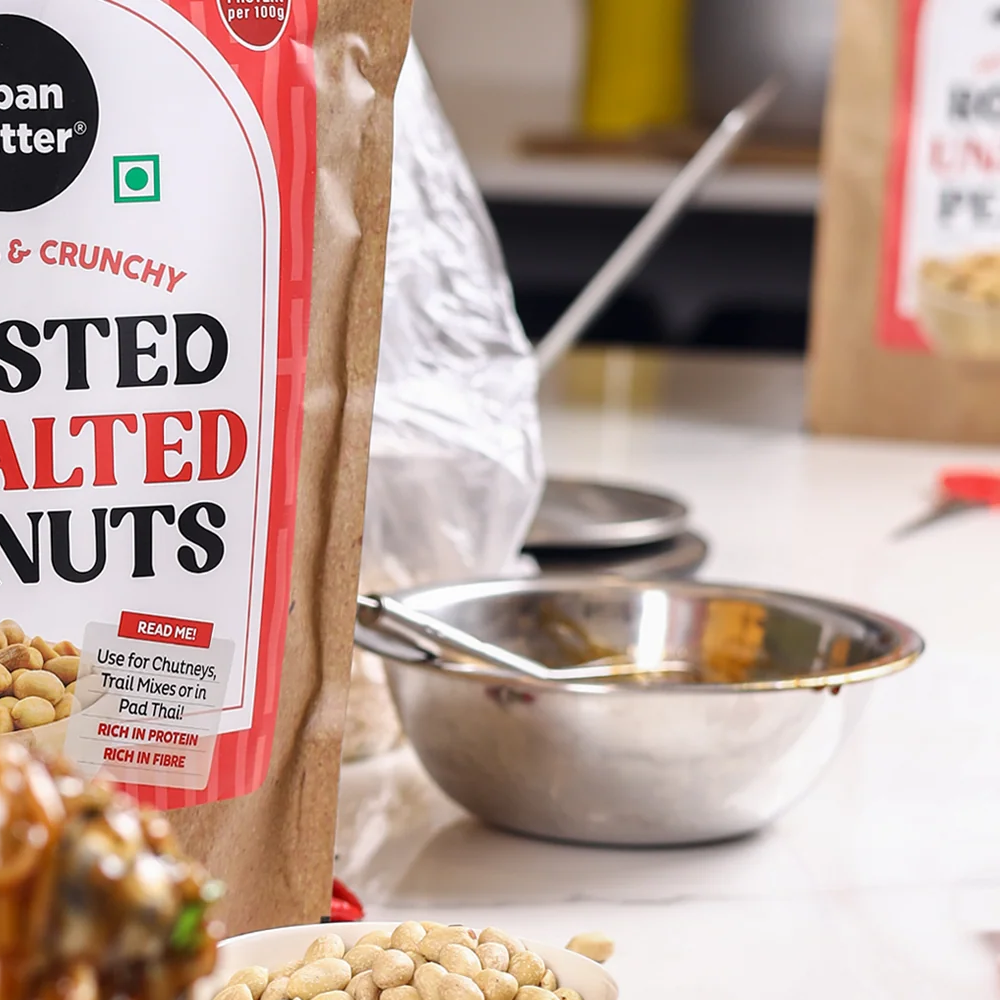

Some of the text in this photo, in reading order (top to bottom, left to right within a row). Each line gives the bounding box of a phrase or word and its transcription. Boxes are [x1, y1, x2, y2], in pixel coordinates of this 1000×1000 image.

[227, 5, 285, 22] per 100g
[7, 238, 32, 264] &
[39, 239, 188, 294] CRUNCHY
[137, 620, 197, 641] READ ME!
[97, 648, 217, 681] Use for Chutneys,
[101, 672, 207, 700] Trail Mixes or in
[118, 698, 185, 720] Pad Thai!
[98, 723, 199, 746] RICH IN PROTEIN
[103, 747, 186, 768] RICH IN FIBRE
